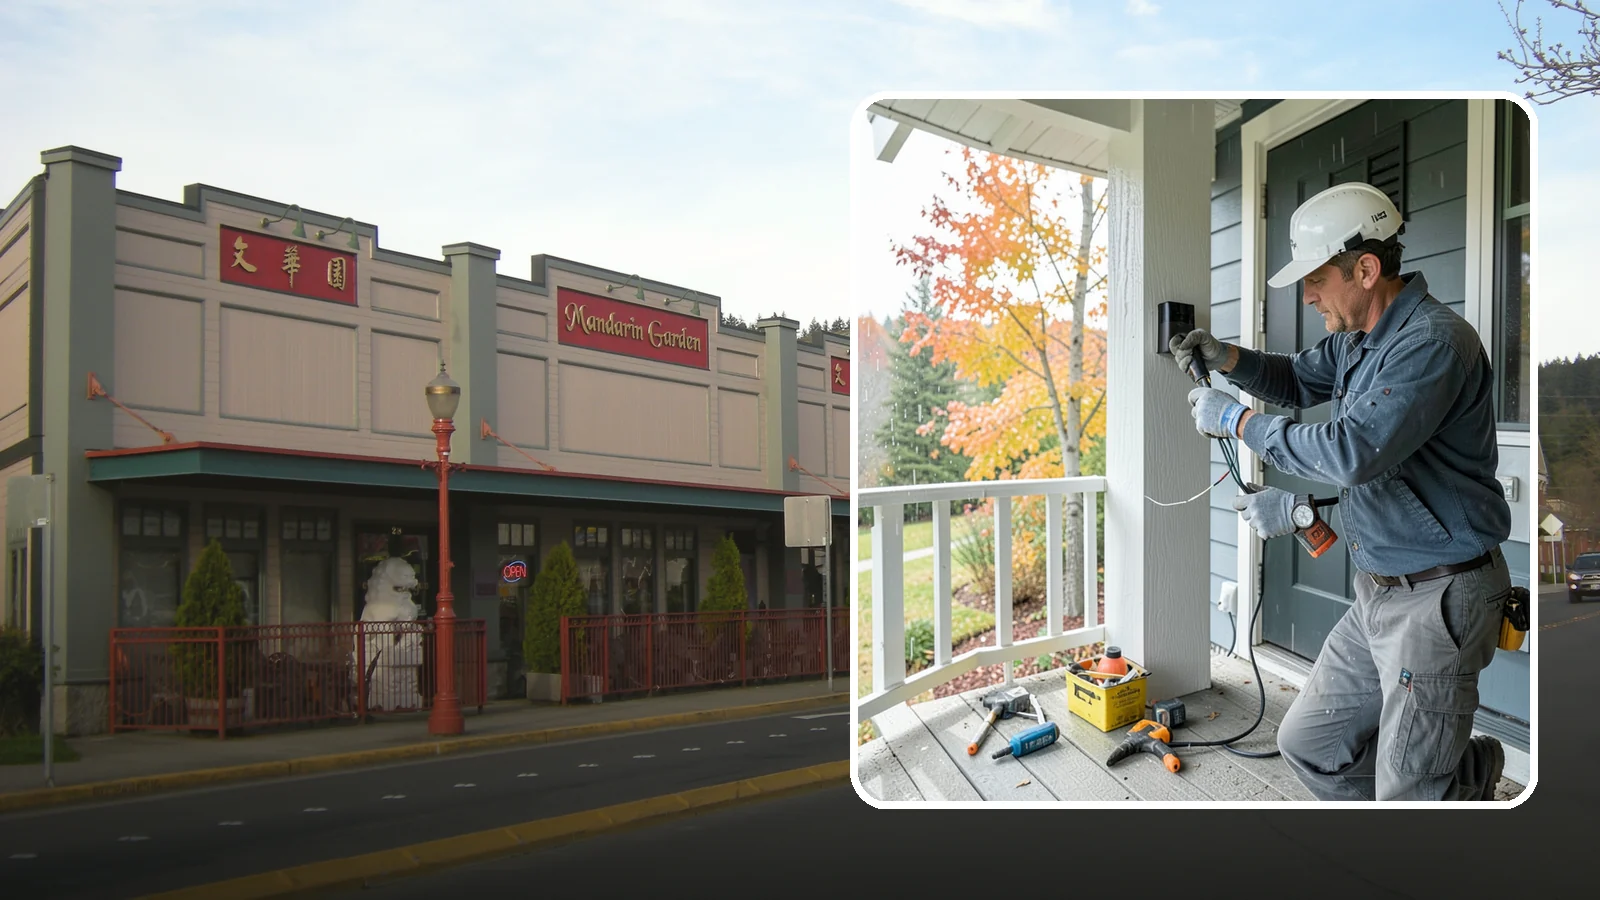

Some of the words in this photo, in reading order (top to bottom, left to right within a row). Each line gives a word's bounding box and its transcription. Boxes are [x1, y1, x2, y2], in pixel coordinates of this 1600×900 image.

[231, 235, 346, 291] 文華園
[565, 302, 644, 341] Mandarin
[648, 320, 702, 352] Garden
[503, 565, 527, 578] OPEN
